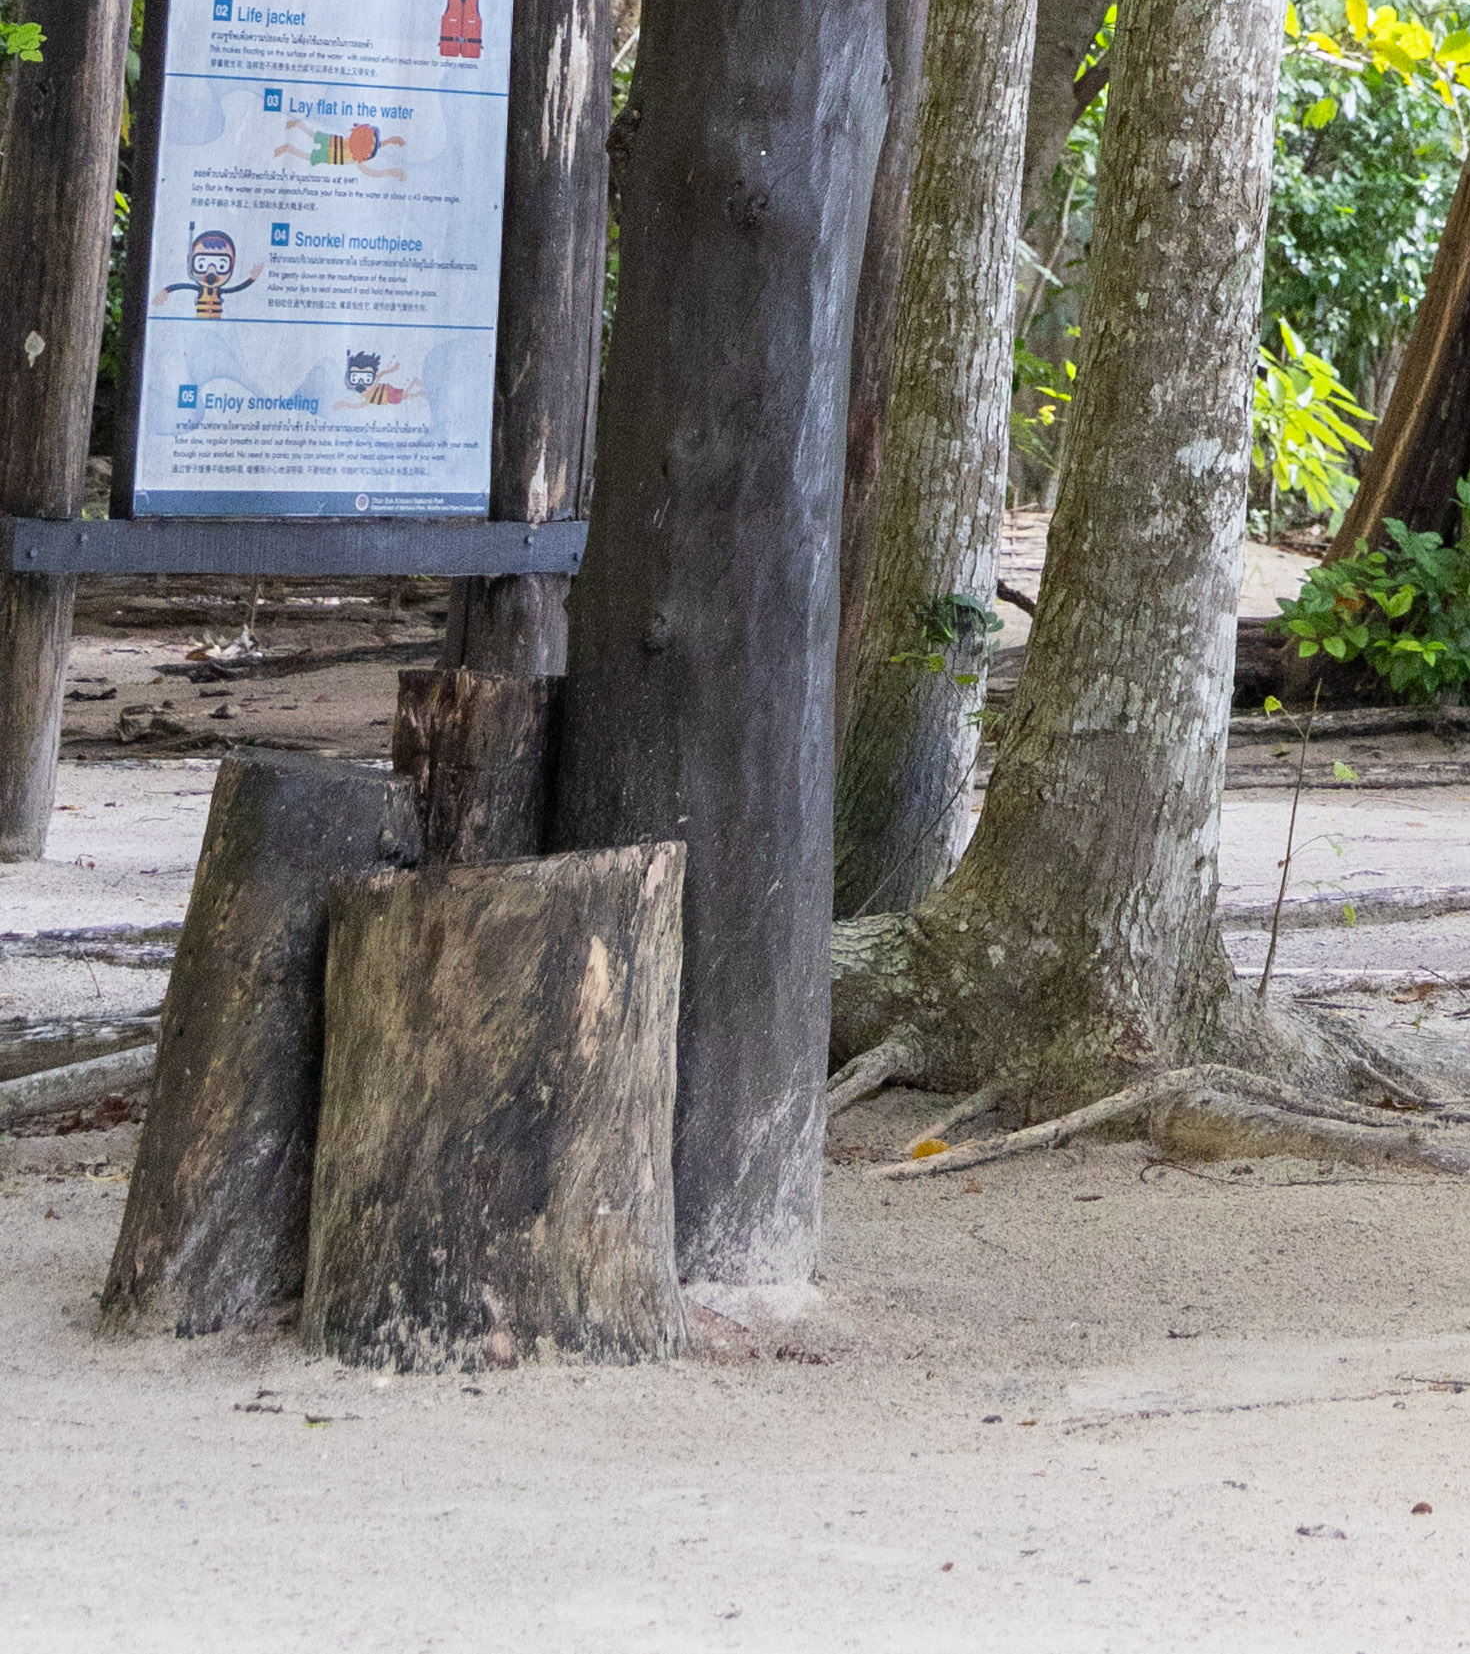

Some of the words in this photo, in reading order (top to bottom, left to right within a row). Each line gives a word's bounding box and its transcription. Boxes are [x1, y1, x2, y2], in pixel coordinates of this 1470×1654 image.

[215, 4, 229, 17] 02
[237, 6, 263, 23] Life
[265, 8, 306, 27] jacket
[266, 94, 279, 107] 03
[289, 98, 313, 118] Lay
[317, 99, 338, 116] flat
[341, 101, 353, 117] in
[357, 101, 377, 118] the
[380, 104, 415, 121] water
[274, 228, 287, 241] 04
[295, 231, 345, 248] Snorkel
[348, 235, 422, 254] mouthpiece
[181, 390, 195, 403] 05
[204, 393, 244, 413] Enjoy
[247, 395, 319, 415] snorkeling
